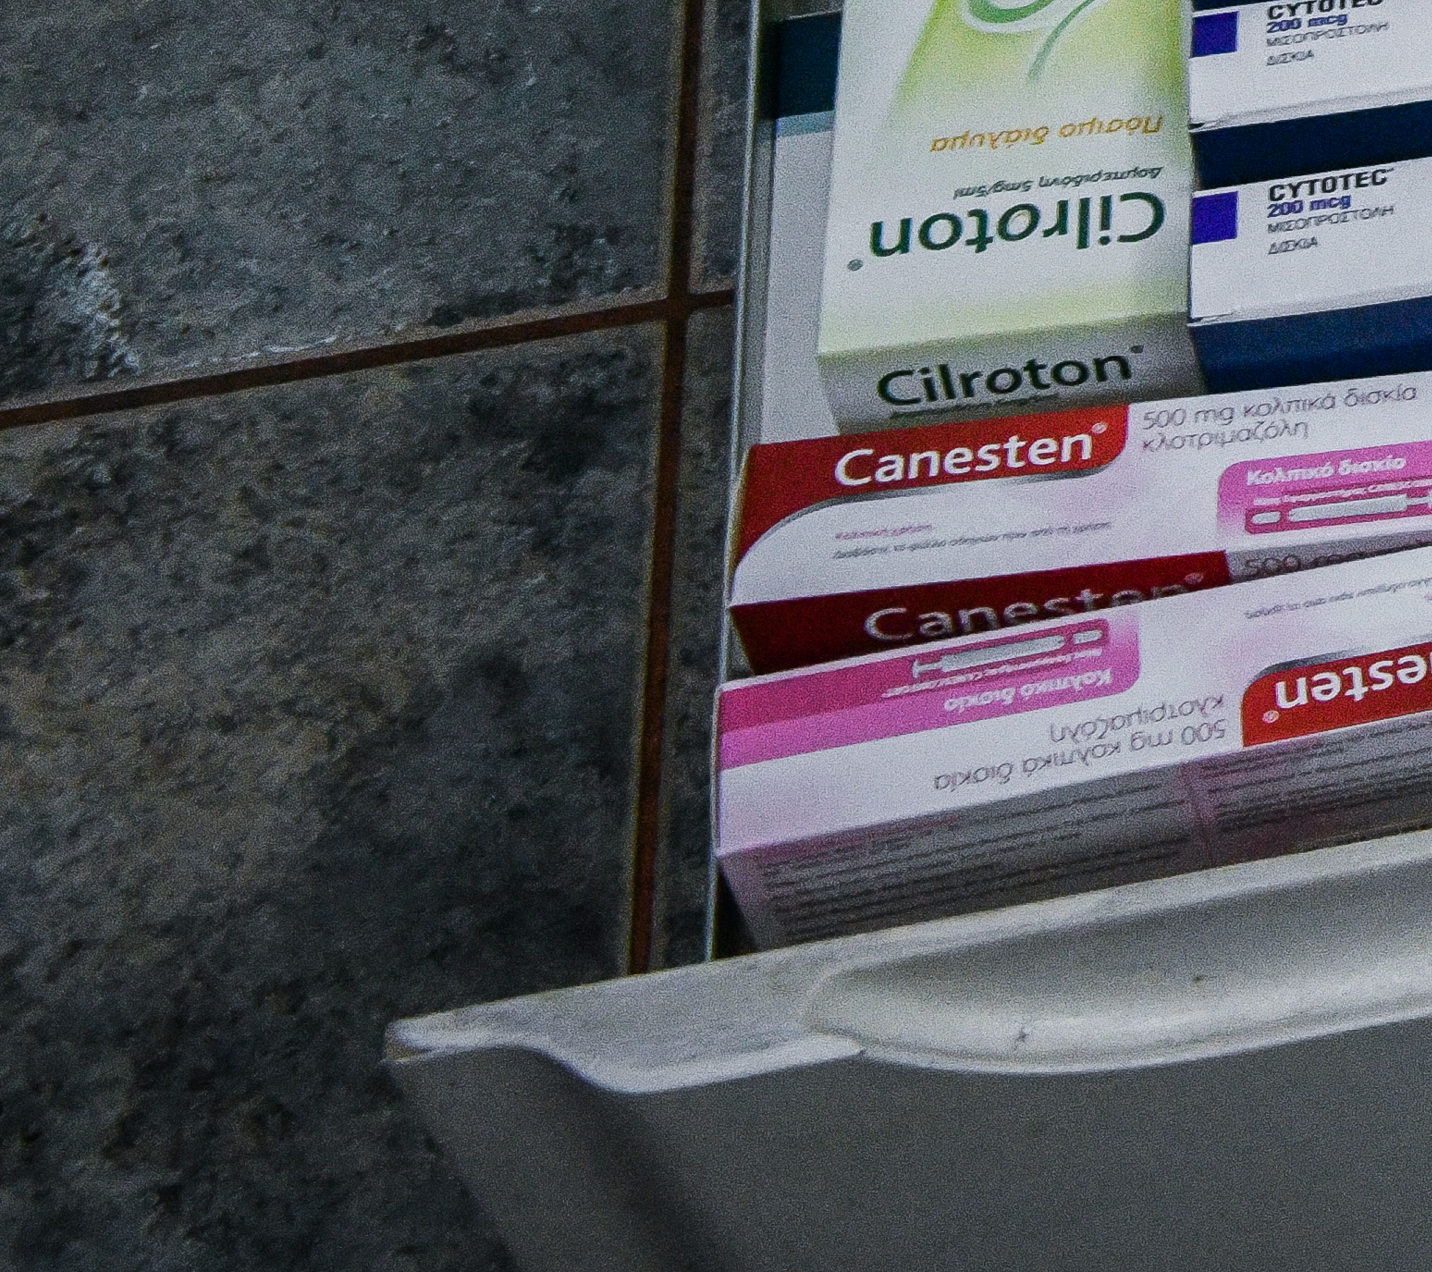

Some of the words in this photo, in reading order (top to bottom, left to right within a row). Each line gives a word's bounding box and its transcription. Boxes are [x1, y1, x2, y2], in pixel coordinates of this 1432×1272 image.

[1264, 17, 1302, 34] 200
[1307, 13, 1348, 28] mcg
[929, 125, 1050, 153] διάλυμα
[1058, 111, 1164, 138] Πόσιμο
[1268, 168, 1388, 202] CYTOTEC
[1267, 199, 1304, 218] 200
[1309, 195, 1352, 211] mcg
[869, 191, 1166, 258] Cilroton
[877, 355, 1132, 406] Cilroton
[1142, 407, 1186, 431] 500
[1193, 406, 1236, 426] mg
[1242, 391, 1337, 418] κολπικά
[1343, 384, 1418, 408] δισκία
[1140, 418, 1309, 453] κλοτριμαζόλη
[834, 425, 1094, 489] Canesten
[1128, 730, 1174, 752] mg
[1180, 718, 1227, 745] 500
